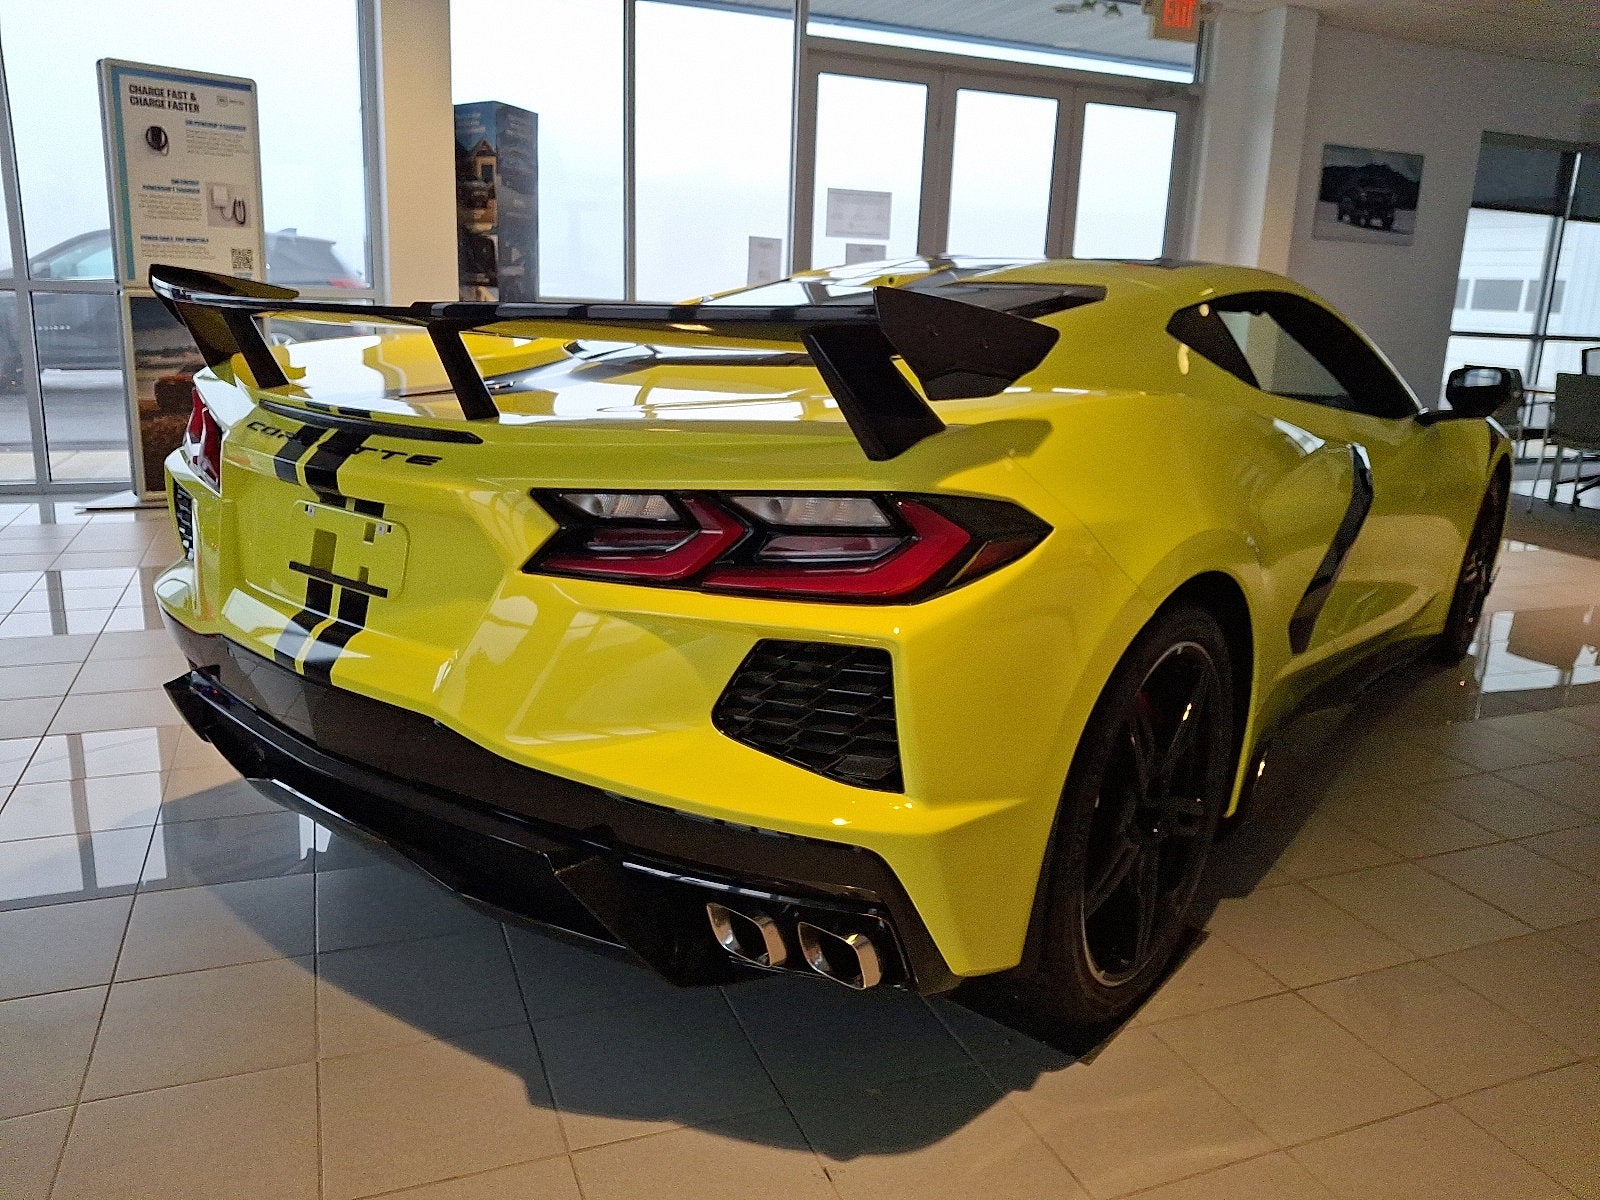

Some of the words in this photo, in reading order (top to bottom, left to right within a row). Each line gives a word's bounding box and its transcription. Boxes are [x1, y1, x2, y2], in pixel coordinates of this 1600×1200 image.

[1163, 0, 1196, 26] EXIT
[129, 84, 165, 98] CHARGE
[167, 89, 188, 100] FAST
[190, 92, 197, 101] &
[130, 96, 166, 109] CHARGE
[167, 101, 200, 113] FASTER
[247, 421, 443, 466] CORTTE
